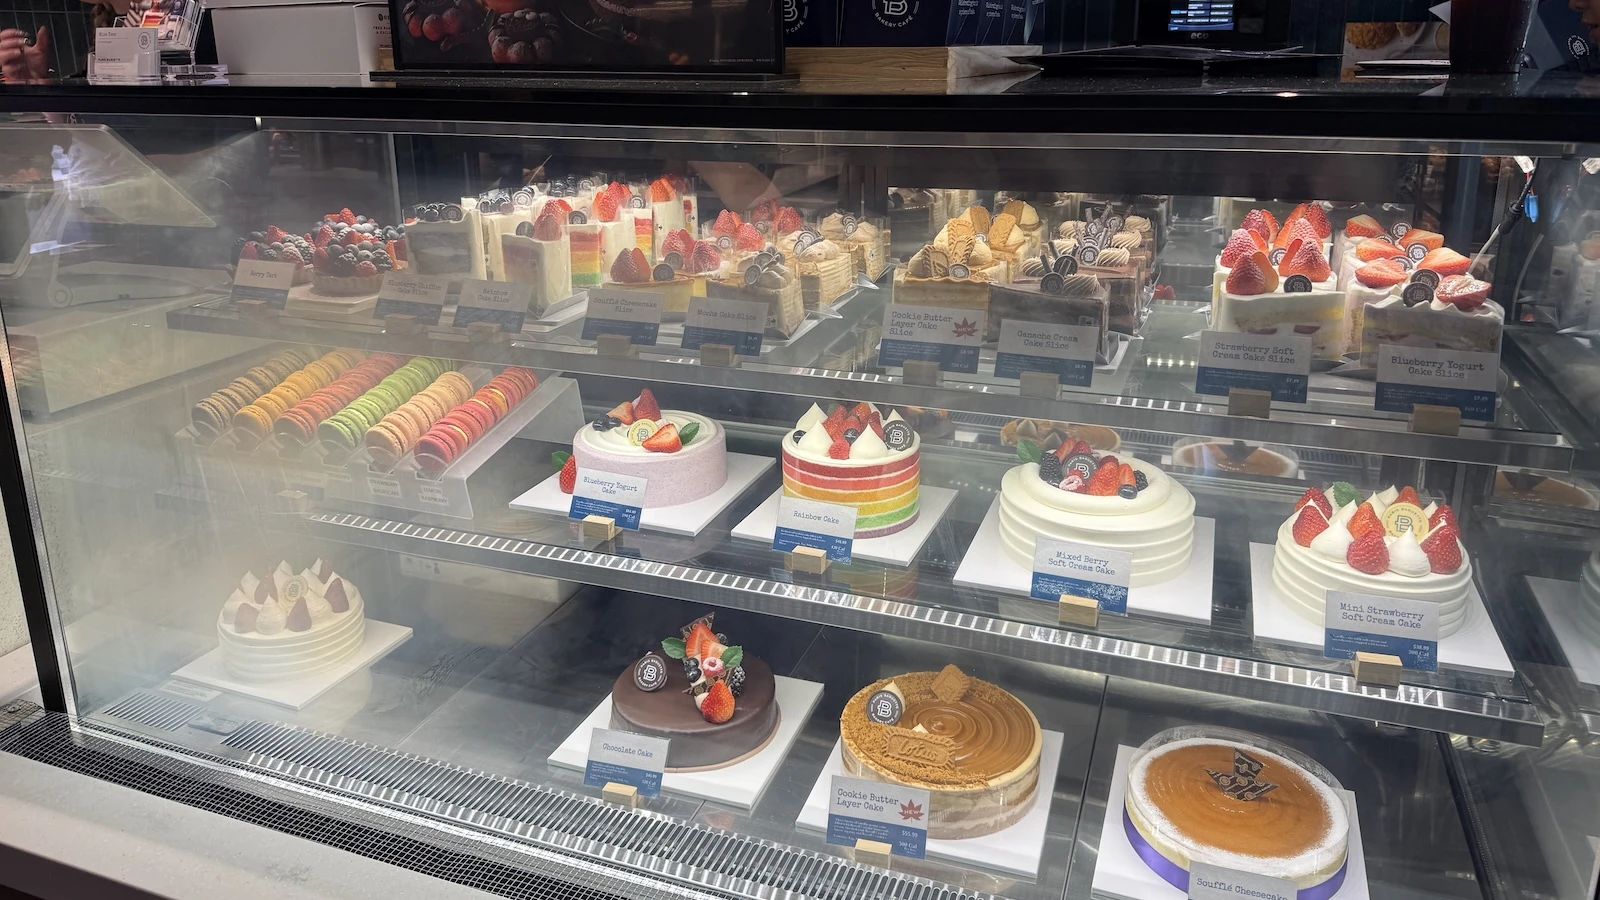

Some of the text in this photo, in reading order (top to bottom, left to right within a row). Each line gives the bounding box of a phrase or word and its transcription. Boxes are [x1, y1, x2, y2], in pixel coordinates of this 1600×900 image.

[875, 12, 897, 27] BAKERY
[397, 287, 428, 296] Cake Slice
[482, 288, 508, 296] Rainbow
[621, 298, 657, 308] Cheesecake
[697, 309, 756, 321] Mocha Cake Slice
[892, 311, 954, 322] Cookie Butter
[891, 320, 937, 330] Layer Cake
[889, 328, 913, 336] Slice
[1017, 330, 1078, 342] Ganache Cream
[1024, 339, 1070, 350] Cake Slice
[1214, 342, 1294, 355] Strawberry Soft
[1212, 350, 1295, 364] Cream Cake Slice
[1391, 356, 1484, 371] Blueberry Yogurt
[1408, 367, 1465, 378] Cake Slice
[583, 476, 638, 492] Blueberry Yogurt
[602, 487, 616, 495] Cake
[793, 510, 839, 524] Rainbow Cake
[1056, 551, 1109, 567] Mixed Berry
[1048, 558, 1116, 575] Soft Cream Cake
[1340, 602, 1424, 622] Mini Strawberry
[1342, 612, 1421, 629] Soft Cream Cake
[602, 742, 653, 758] Chocolate Cake
[837, 788, 899, 805] Cookie Butter
[837, 798, 884, 812] Layer Cake
[902, 830, 918, 838] $55.99
[1196, 878, 1232, 892] Soufflé
